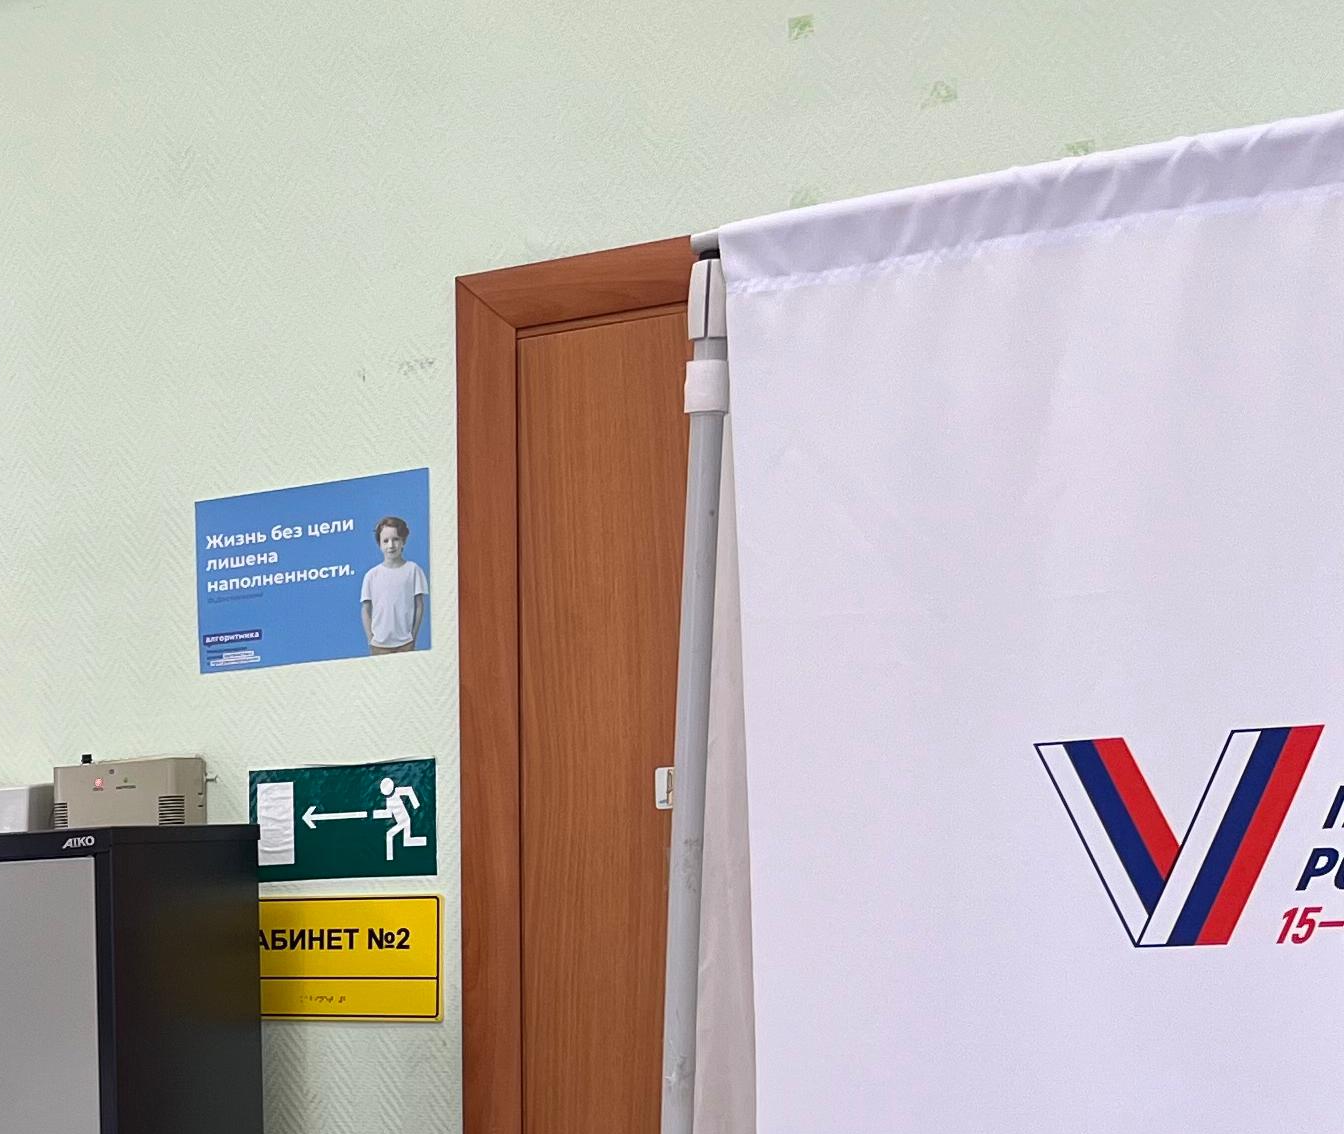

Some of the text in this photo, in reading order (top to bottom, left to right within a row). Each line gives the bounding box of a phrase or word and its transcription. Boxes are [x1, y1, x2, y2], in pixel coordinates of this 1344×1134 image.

[206, 519, 354, 550] Жизнь без цели
[206, 550, 279, 571] лишена
[207, 563, 355, 592] наполненности.
[62, 835, 95, 849] AIKO
[259, 928, 410, 950] АБИНЕТ №2
